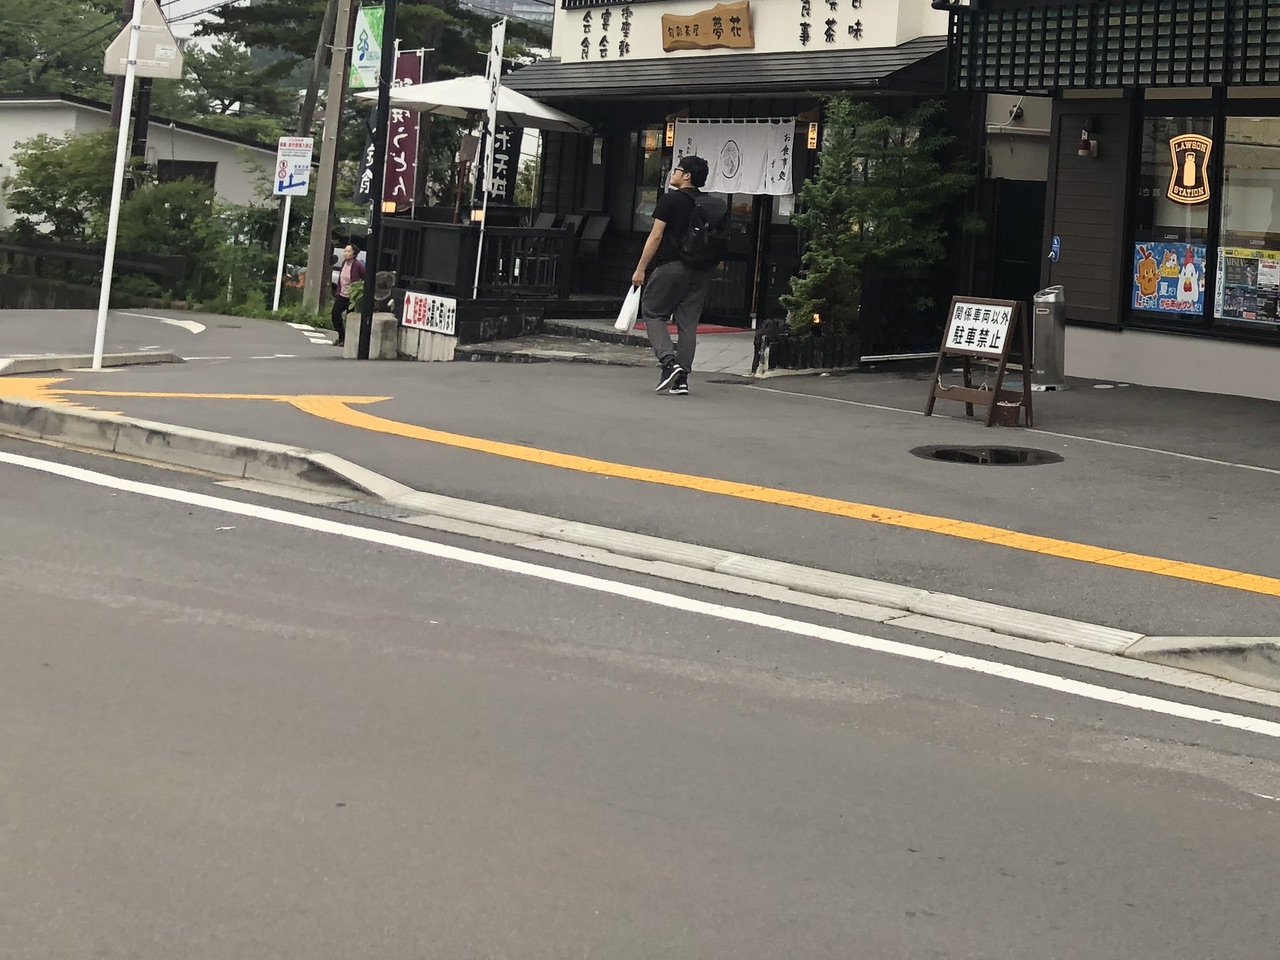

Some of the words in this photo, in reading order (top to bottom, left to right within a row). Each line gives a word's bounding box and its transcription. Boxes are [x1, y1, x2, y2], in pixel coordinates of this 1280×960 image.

[580, 10, 593, 60] 会食
[599, 8, 611, 59] 宴会
[1175, 141, 1207, 153] LAWSON
[1173, 186, 1205, 197] STATION
[954, 305, 1010, 326] 関係車両以外
[951, 326, 1002, 350] 駐車禁止
